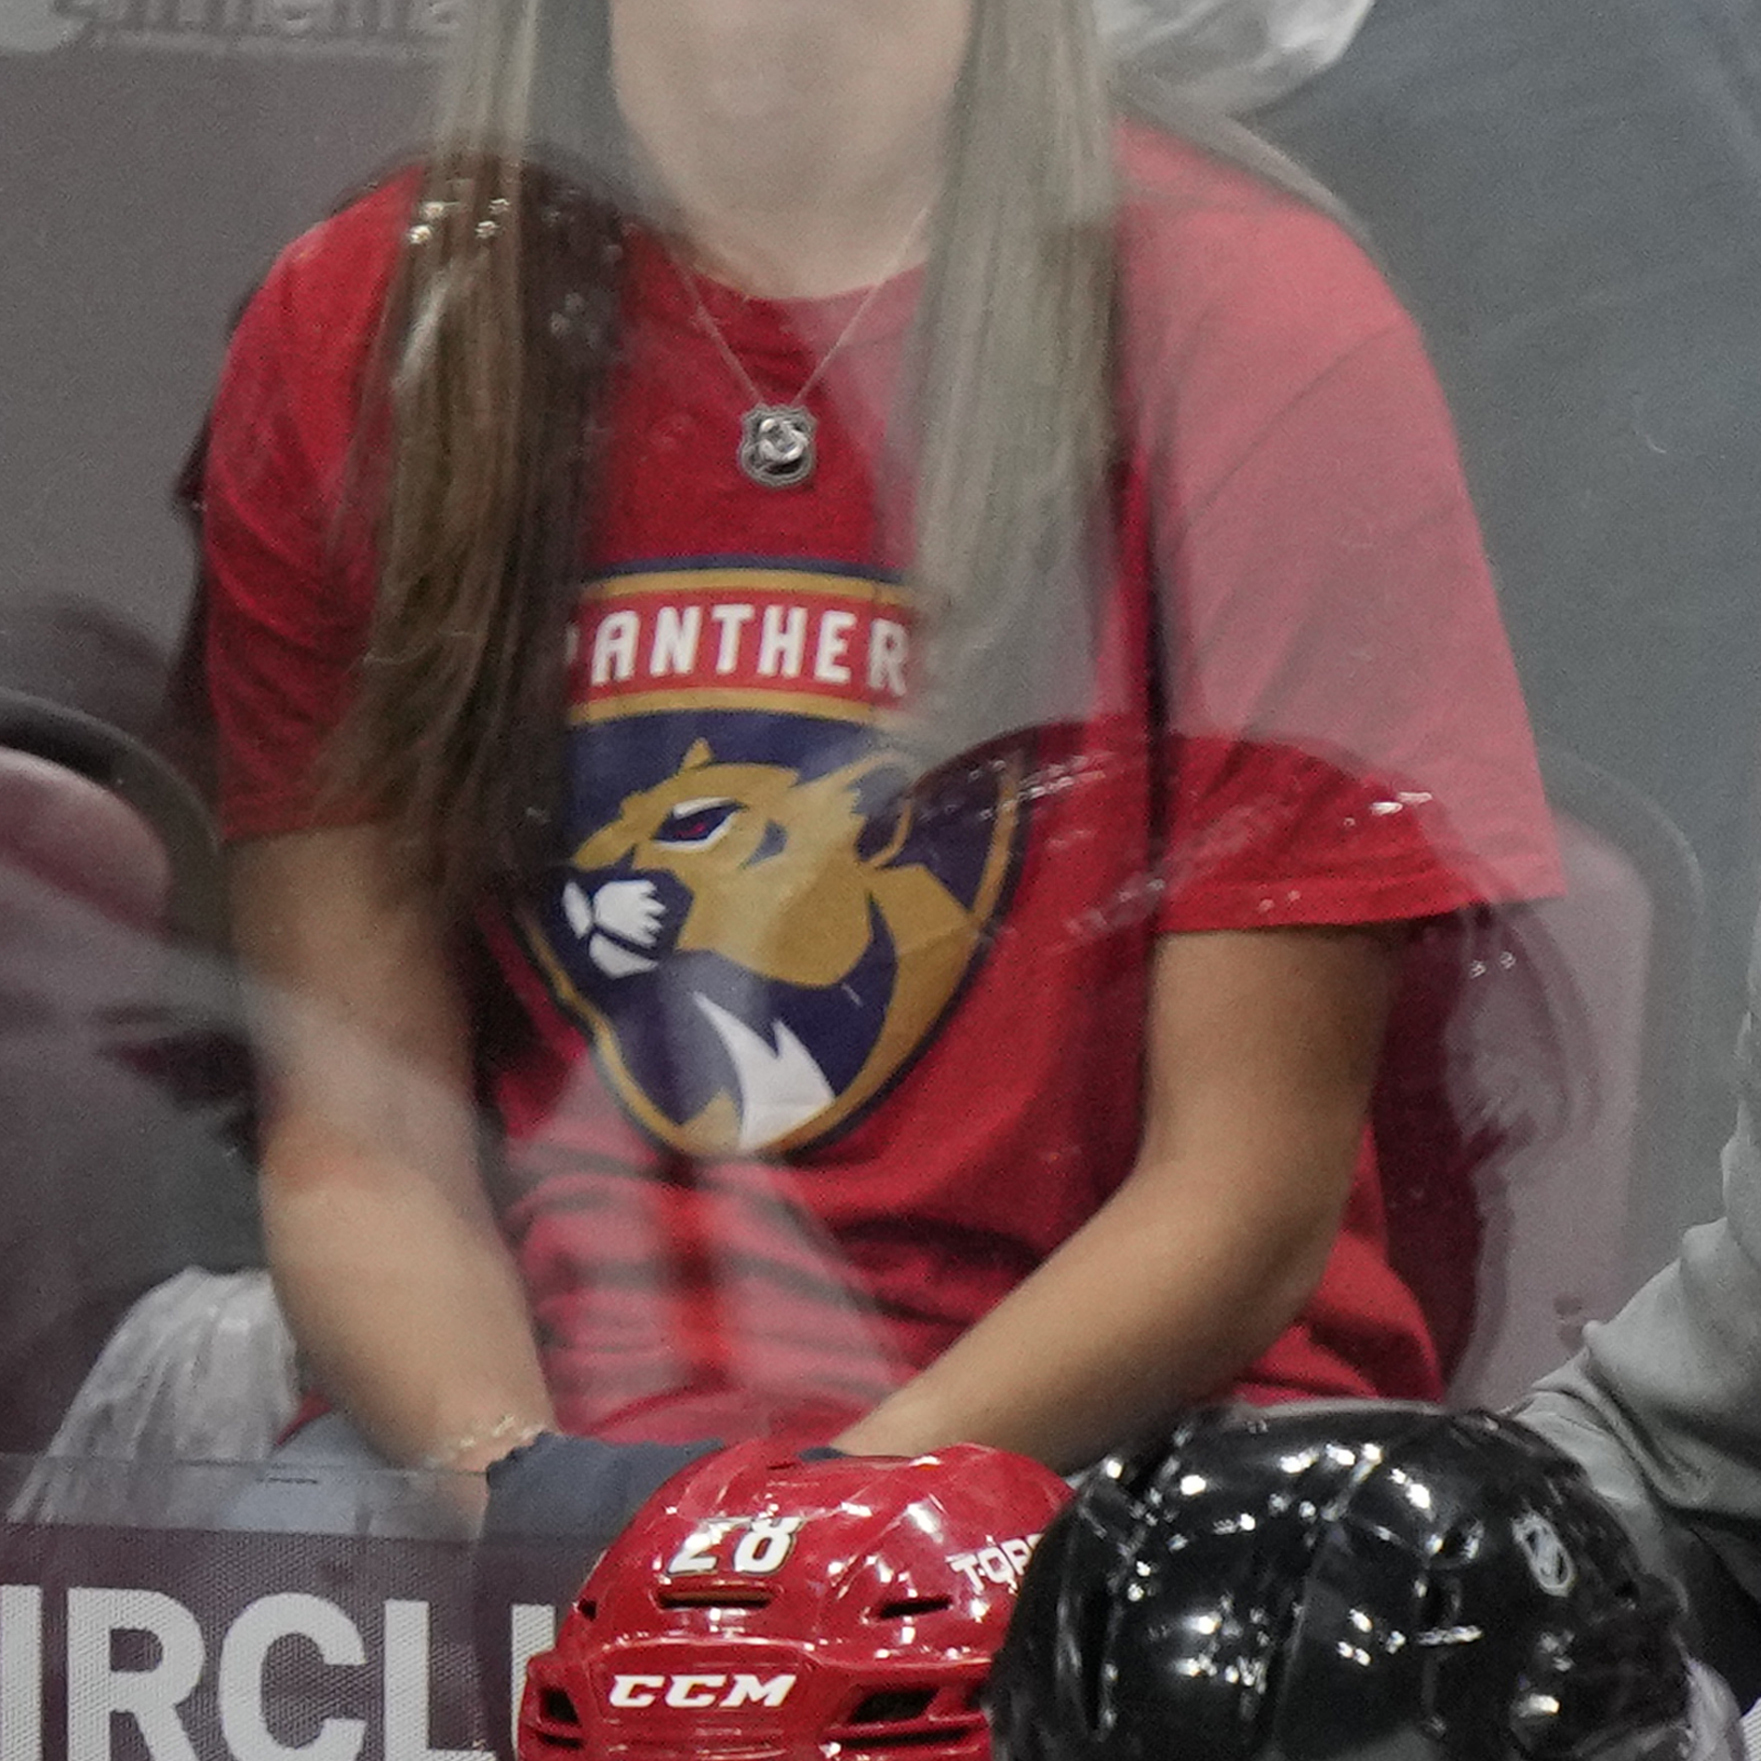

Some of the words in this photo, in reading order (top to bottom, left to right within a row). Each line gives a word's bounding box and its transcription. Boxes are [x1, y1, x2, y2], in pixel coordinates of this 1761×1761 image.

[564, 603, 908, 698] ANTHER
[946, 1533, 1046, 1595] TOP
[609, 1675, 796, 1708] CCM
